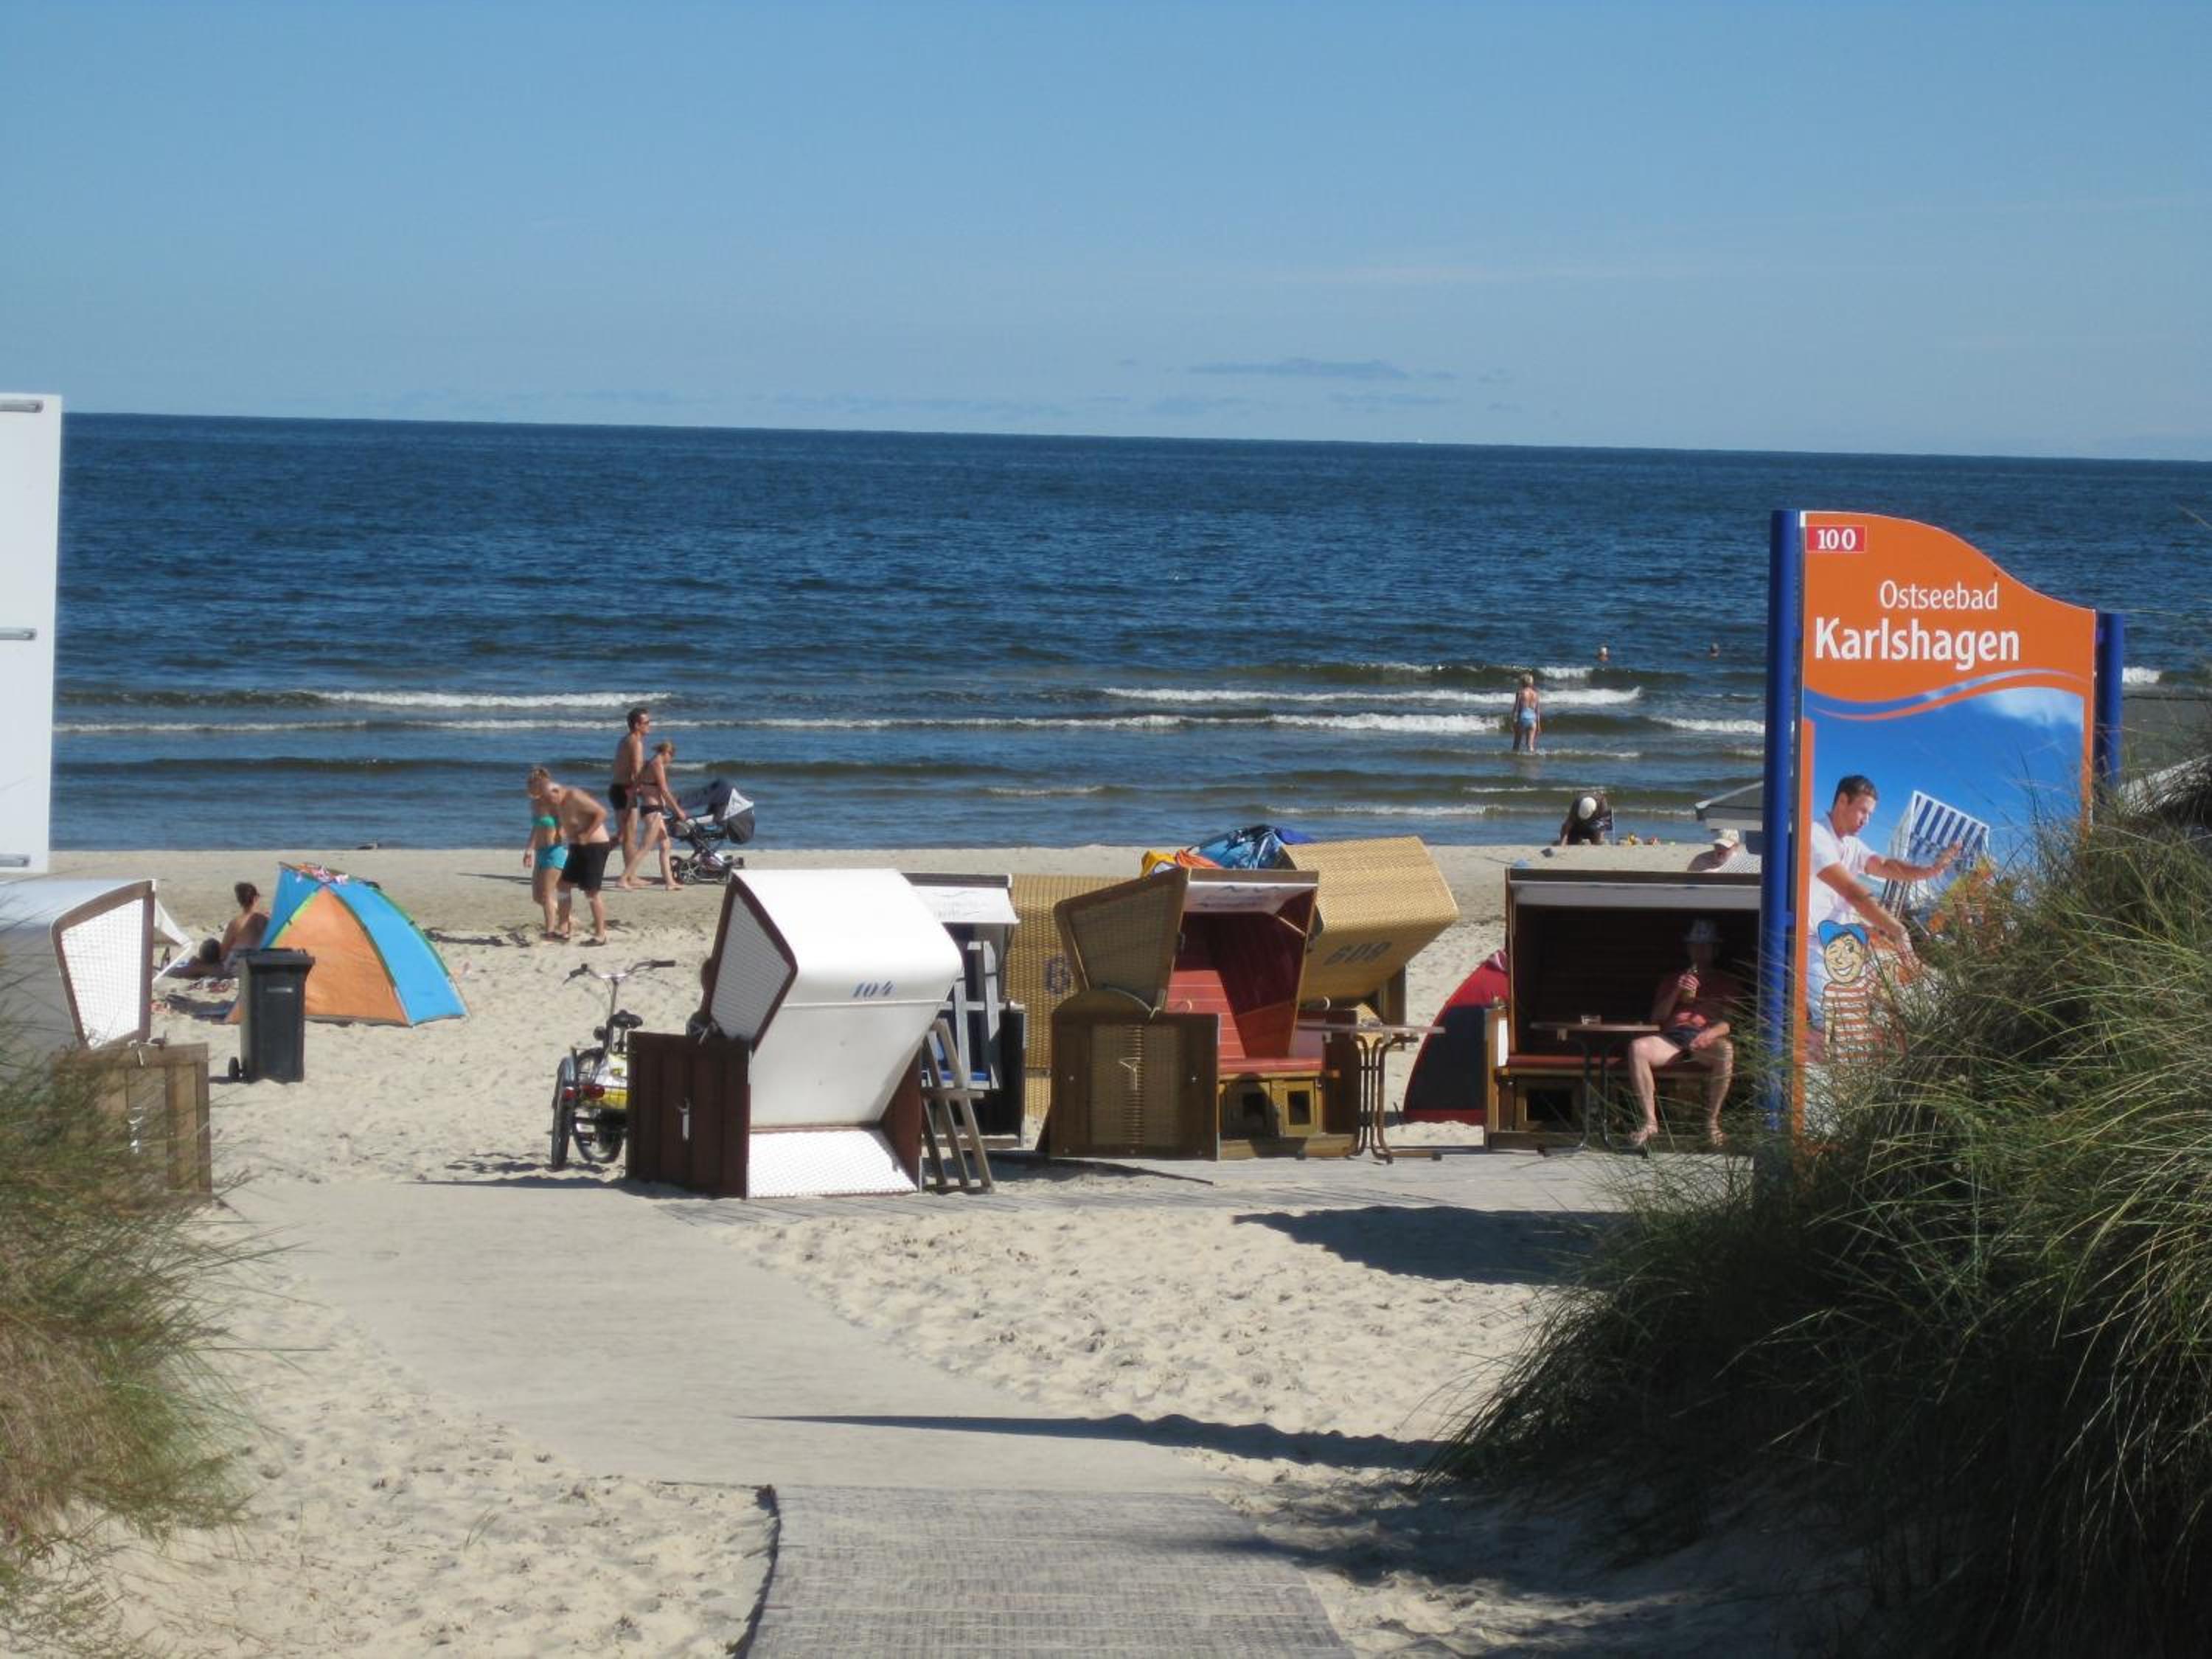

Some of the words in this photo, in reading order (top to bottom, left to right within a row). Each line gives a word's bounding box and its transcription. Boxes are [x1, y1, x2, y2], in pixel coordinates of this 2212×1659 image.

[1817, 529, 1857, 551] 100
[1879, 580, 1998, 610] Ostseebad
[1815, 617, 2020, 671] Karlshagen
